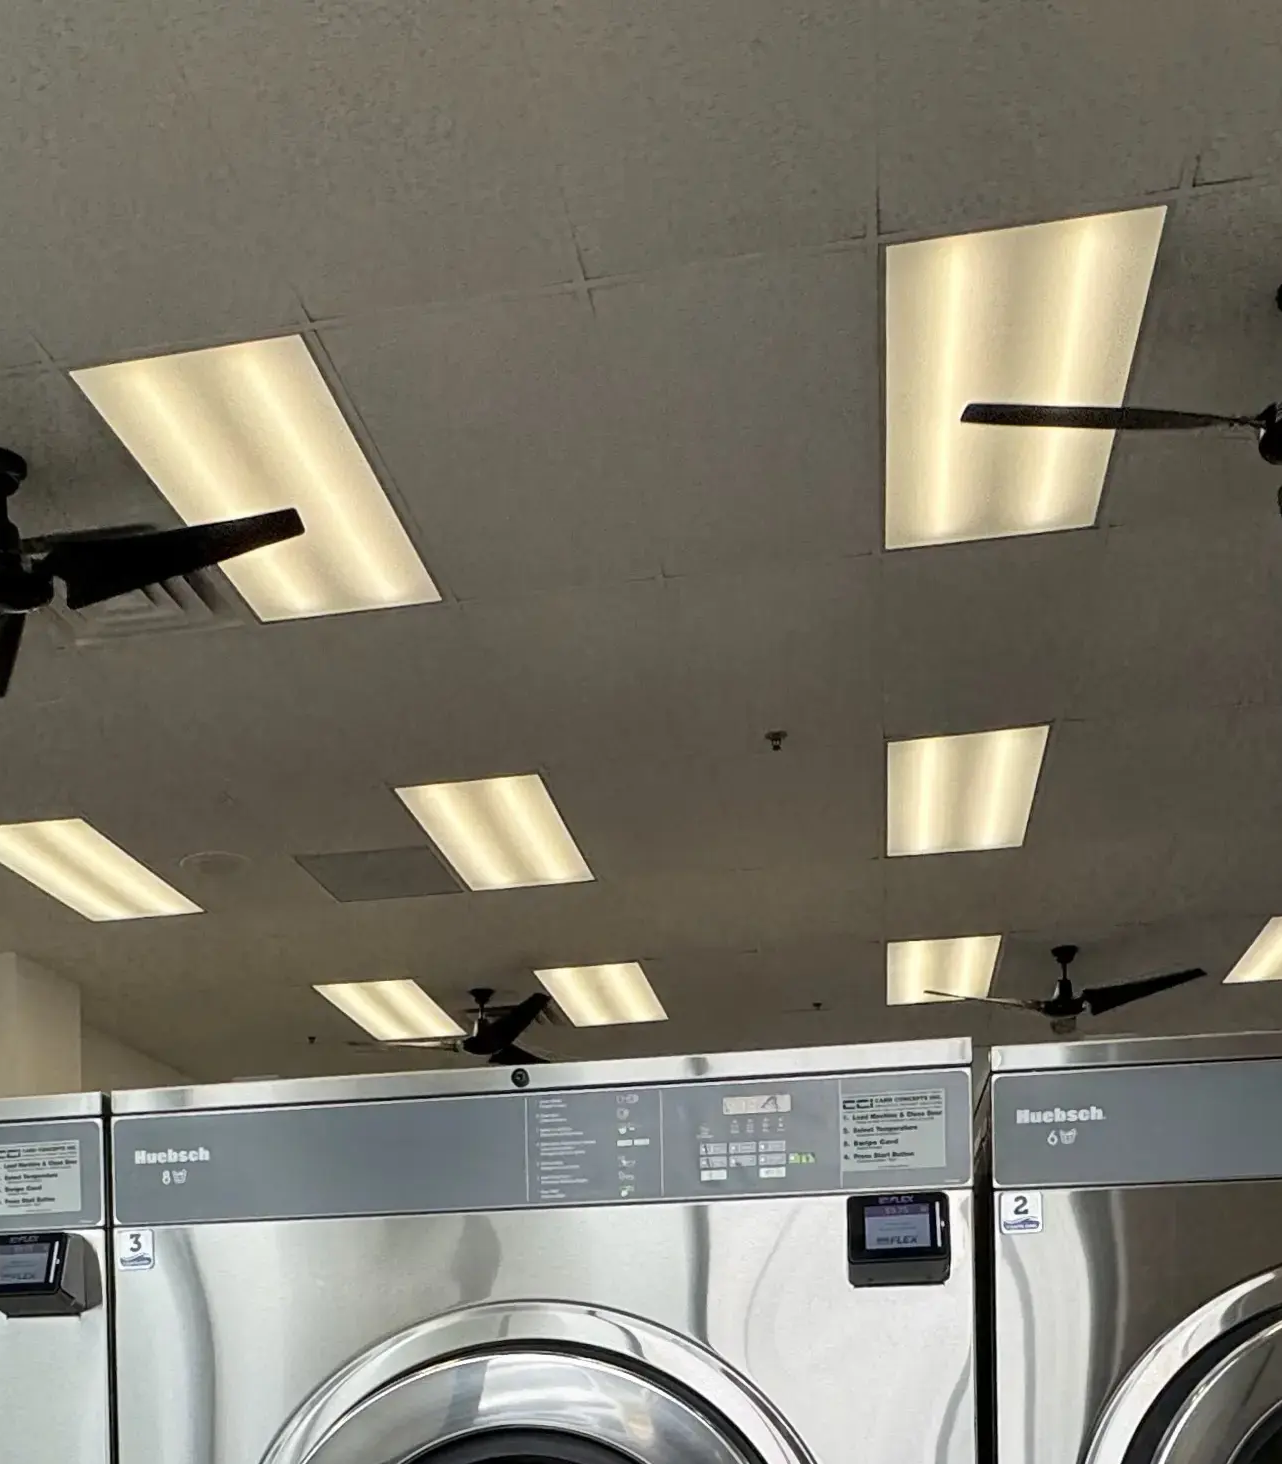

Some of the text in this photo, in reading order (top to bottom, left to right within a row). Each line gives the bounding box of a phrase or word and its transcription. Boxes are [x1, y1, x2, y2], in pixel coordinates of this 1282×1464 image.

[1016, 1106, 1104, 1124] Huebsch
[1047, 1130, 1059, 1146] 6
[134, 1147, 210, 1164] Huebsch
[161, 1170, 172, 1185] 8
[1013, 1195, 1029, 1215] 2
[129, 1233, 142, 1253] 3
